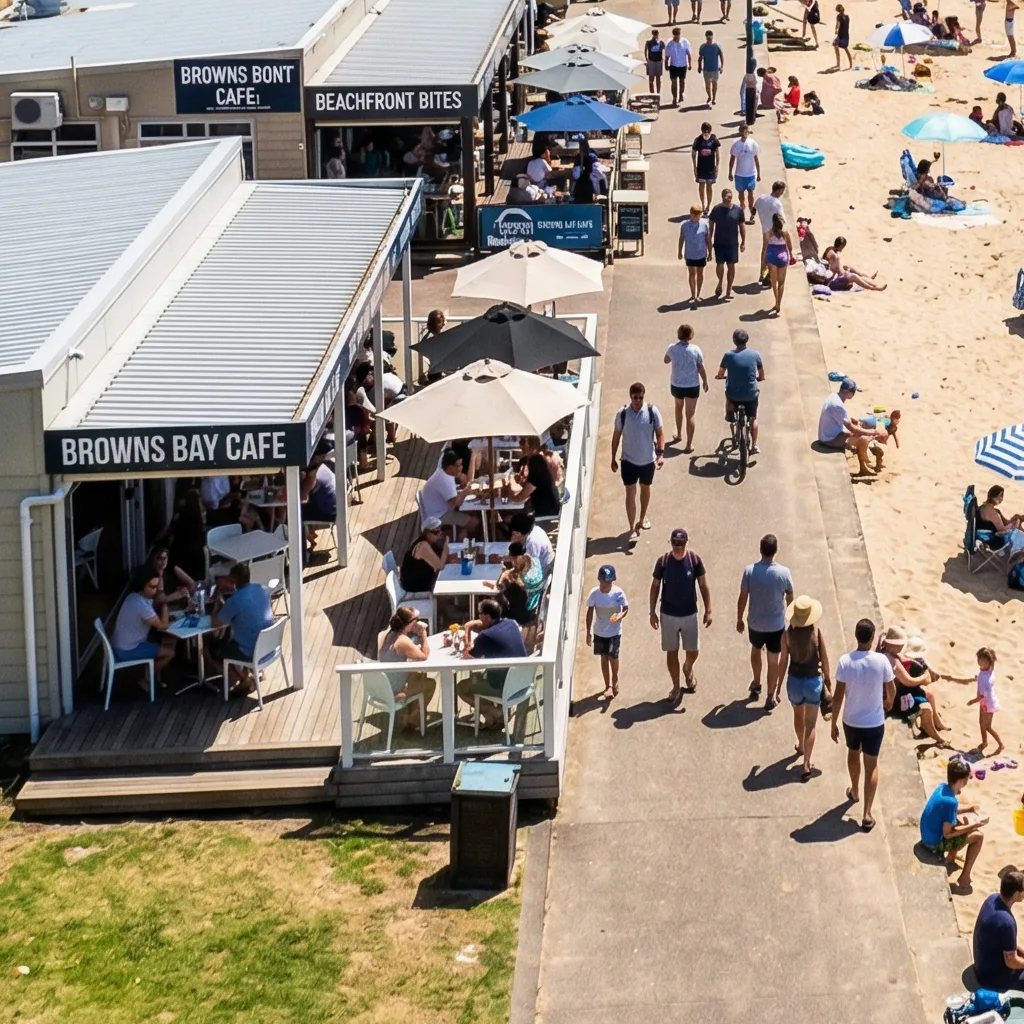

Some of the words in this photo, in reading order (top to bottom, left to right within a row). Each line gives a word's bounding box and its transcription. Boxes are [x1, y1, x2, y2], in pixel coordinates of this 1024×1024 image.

[181, 65, 248, 85] BROWNS
[315, 91, 415, 111] BEACHFRONT
[418, 90, 462, 110] BITES
[61, 434, 165, 466] BROWNS
[172, 433, 219, 462] BAY
[225, 431, 287, 461] CAFE
